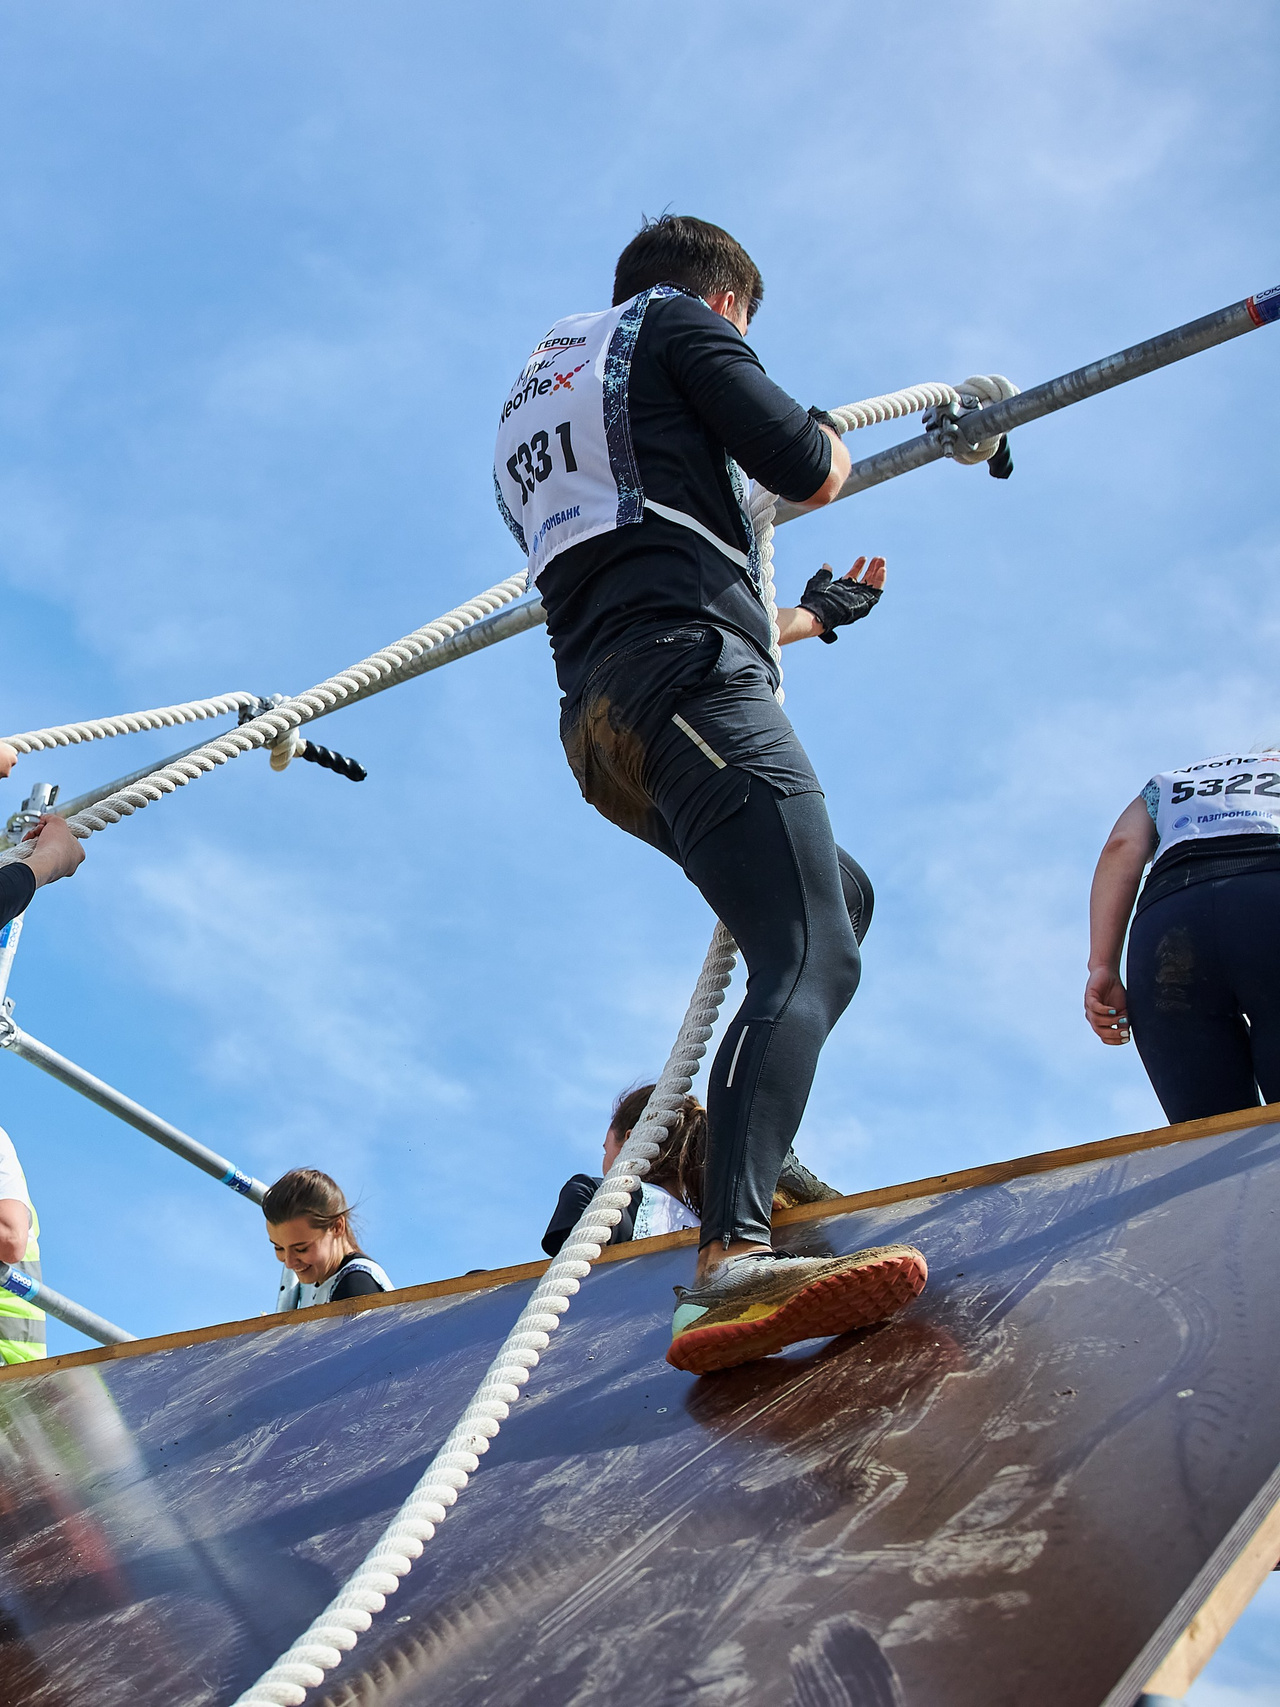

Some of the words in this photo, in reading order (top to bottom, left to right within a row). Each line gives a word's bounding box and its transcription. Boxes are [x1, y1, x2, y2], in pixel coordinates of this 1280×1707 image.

[537, 336, 587, 351] ГЕРОЕВ
[506, 421, 578, 507] 5331
[1170, 773, 1280, 805] 5322
[1196, 810, 1273, 824] ГАЗПРОМБАНК
